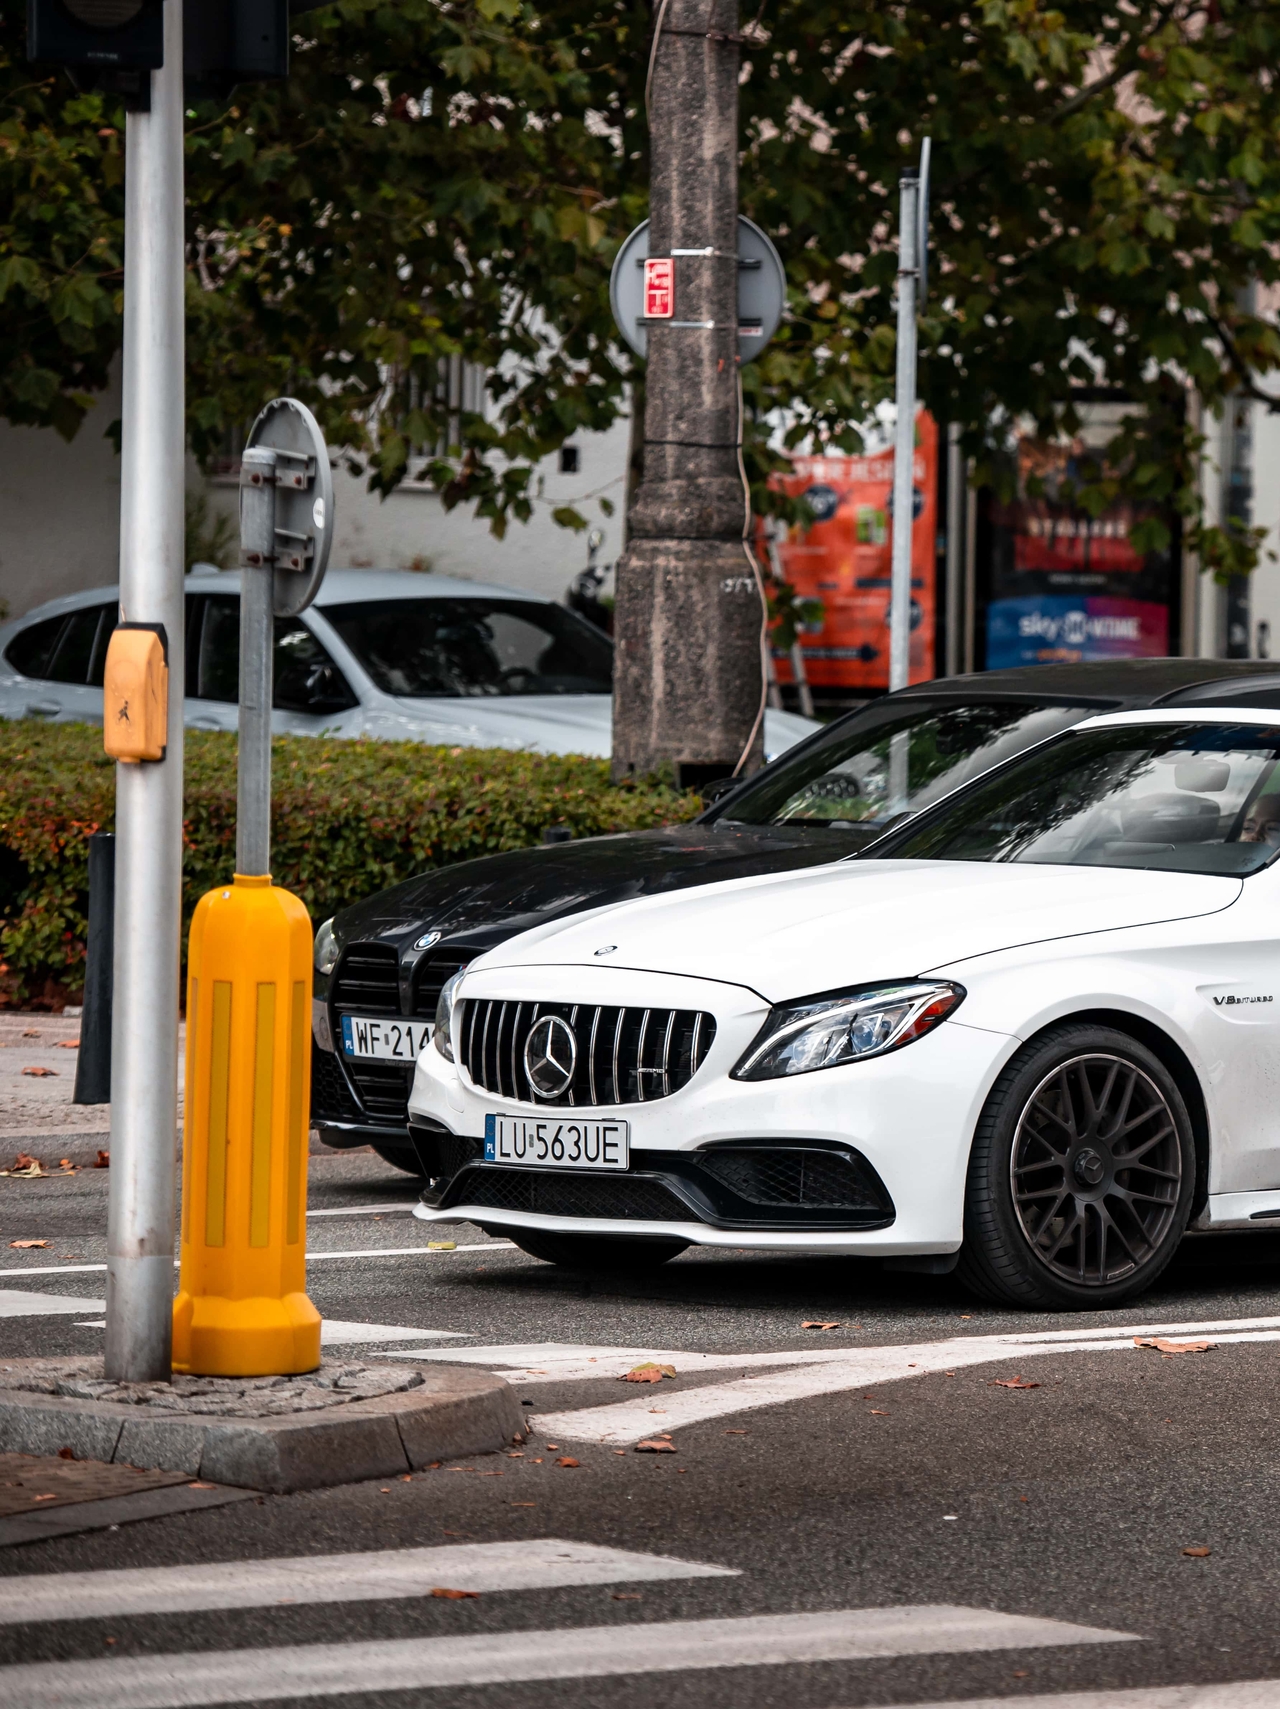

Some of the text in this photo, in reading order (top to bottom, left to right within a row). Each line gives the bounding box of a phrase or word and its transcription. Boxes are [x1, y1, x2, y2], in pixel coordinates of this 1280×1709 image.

[345, 1040, 353, 1049] PL
[356, 1021, 435, 1057] WF 214
[486, 1143, 494, 1153] PL
[500, 1121, 619, 1163] LU 563UE
